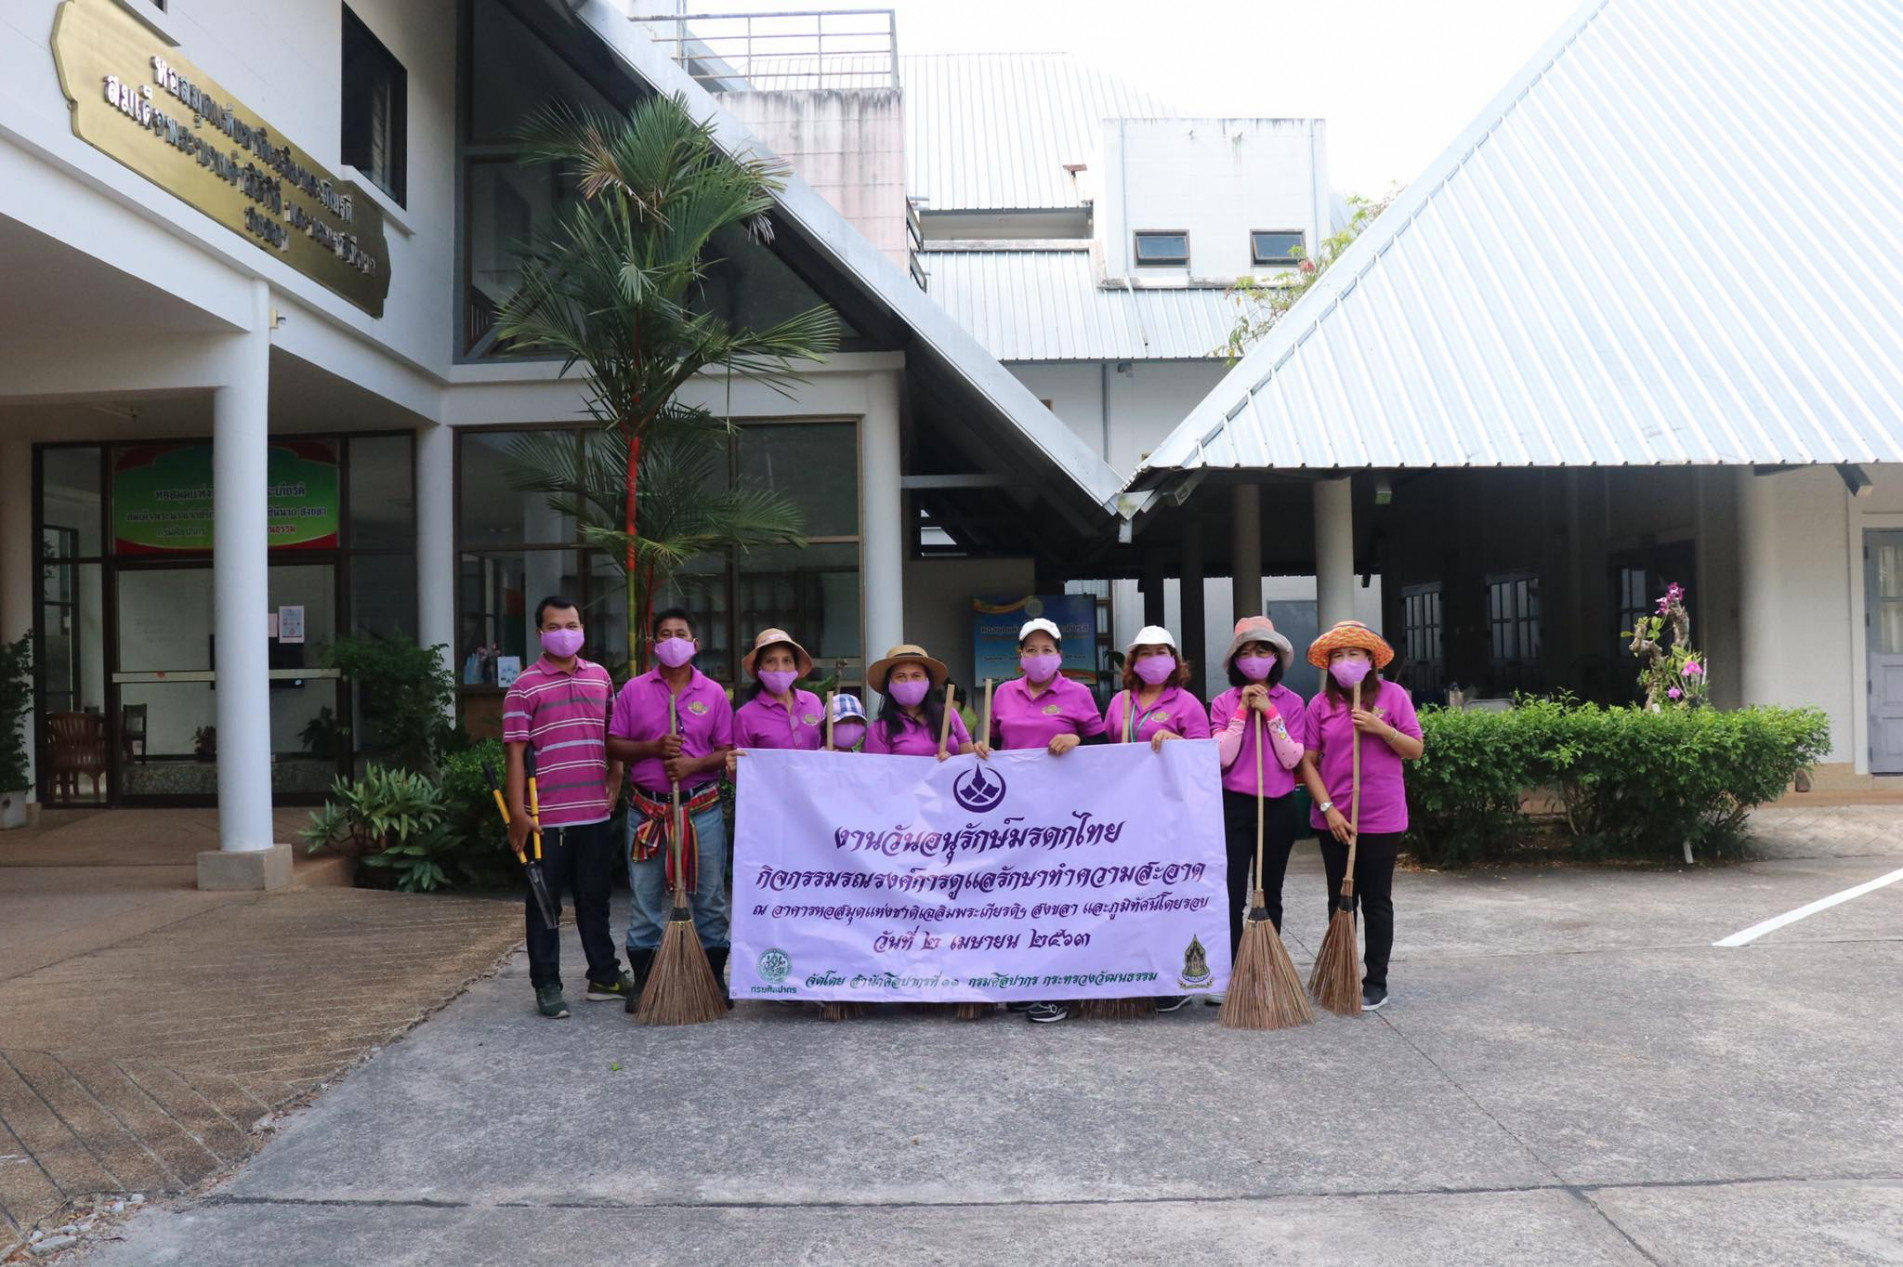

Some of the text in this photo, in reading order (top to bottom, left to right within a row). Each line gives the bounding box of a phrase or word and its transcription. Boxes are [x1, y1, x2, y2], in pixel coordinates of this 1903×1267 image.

[834, 811, 1126, 865] งานวันอนุรักษ์มรดกไทย
[756, 862, 1206, 900] กิจกรรมรณรงค์การดูแลรักษาทำความสะอาด
[753, 904, 767, 915] ณ
[1031, 902, 1078, 919] สงขลา
[874, 926, 1091, 952] วันที่ ๒ เมษายน ๒๕๖๓
[805, 970, 846, 988] จัดโดย
[968, 972, 1039, 988] กรมศิลปากร
[1042, 971, 1157, 986] กระทรวงวัฒนธรรม
